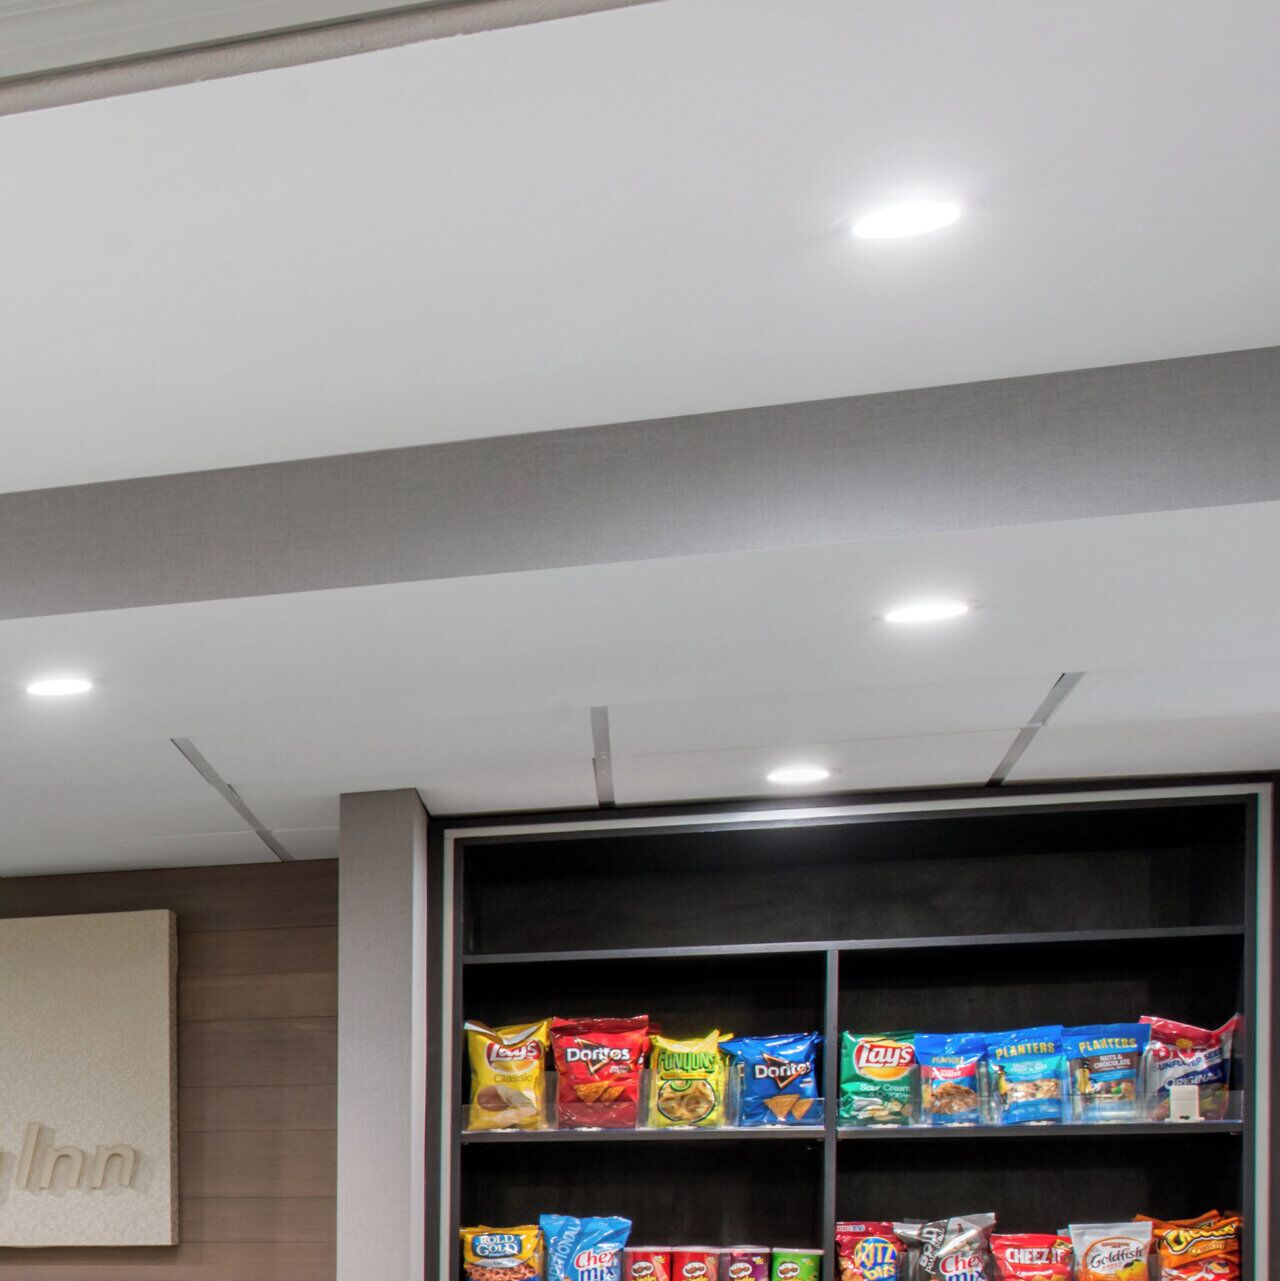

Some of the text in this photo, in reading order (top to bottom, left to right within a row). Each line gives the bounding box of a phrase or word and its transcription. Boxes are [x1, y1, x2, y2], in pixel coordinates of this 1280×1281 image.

[995, 1042, 1055, 1060] PLANTERS
[1078, 1037, 1138, 1053] PLANTERS
[566, 1047, 631, 1063] Doritos
[494, 1073, 533, 1083] Classic
[755, 1061, 812, 1079] Doritos
[859, 1083, 911, 1092] Sour Cream
[17, 1121, 142, 1190] Inn
[479, 1234, 515, 1245] ROLD
[476, 1243, 518, 1256] GOLD
[574, 1248, 615, 1269] Chex
[854, 1242, 896, 1270] RITZ
[1090, 1246, 1143, 1268] Goldfish
[940, 1251, 983, 1274] Chex
[864, 1263, 896, 1281] bits
